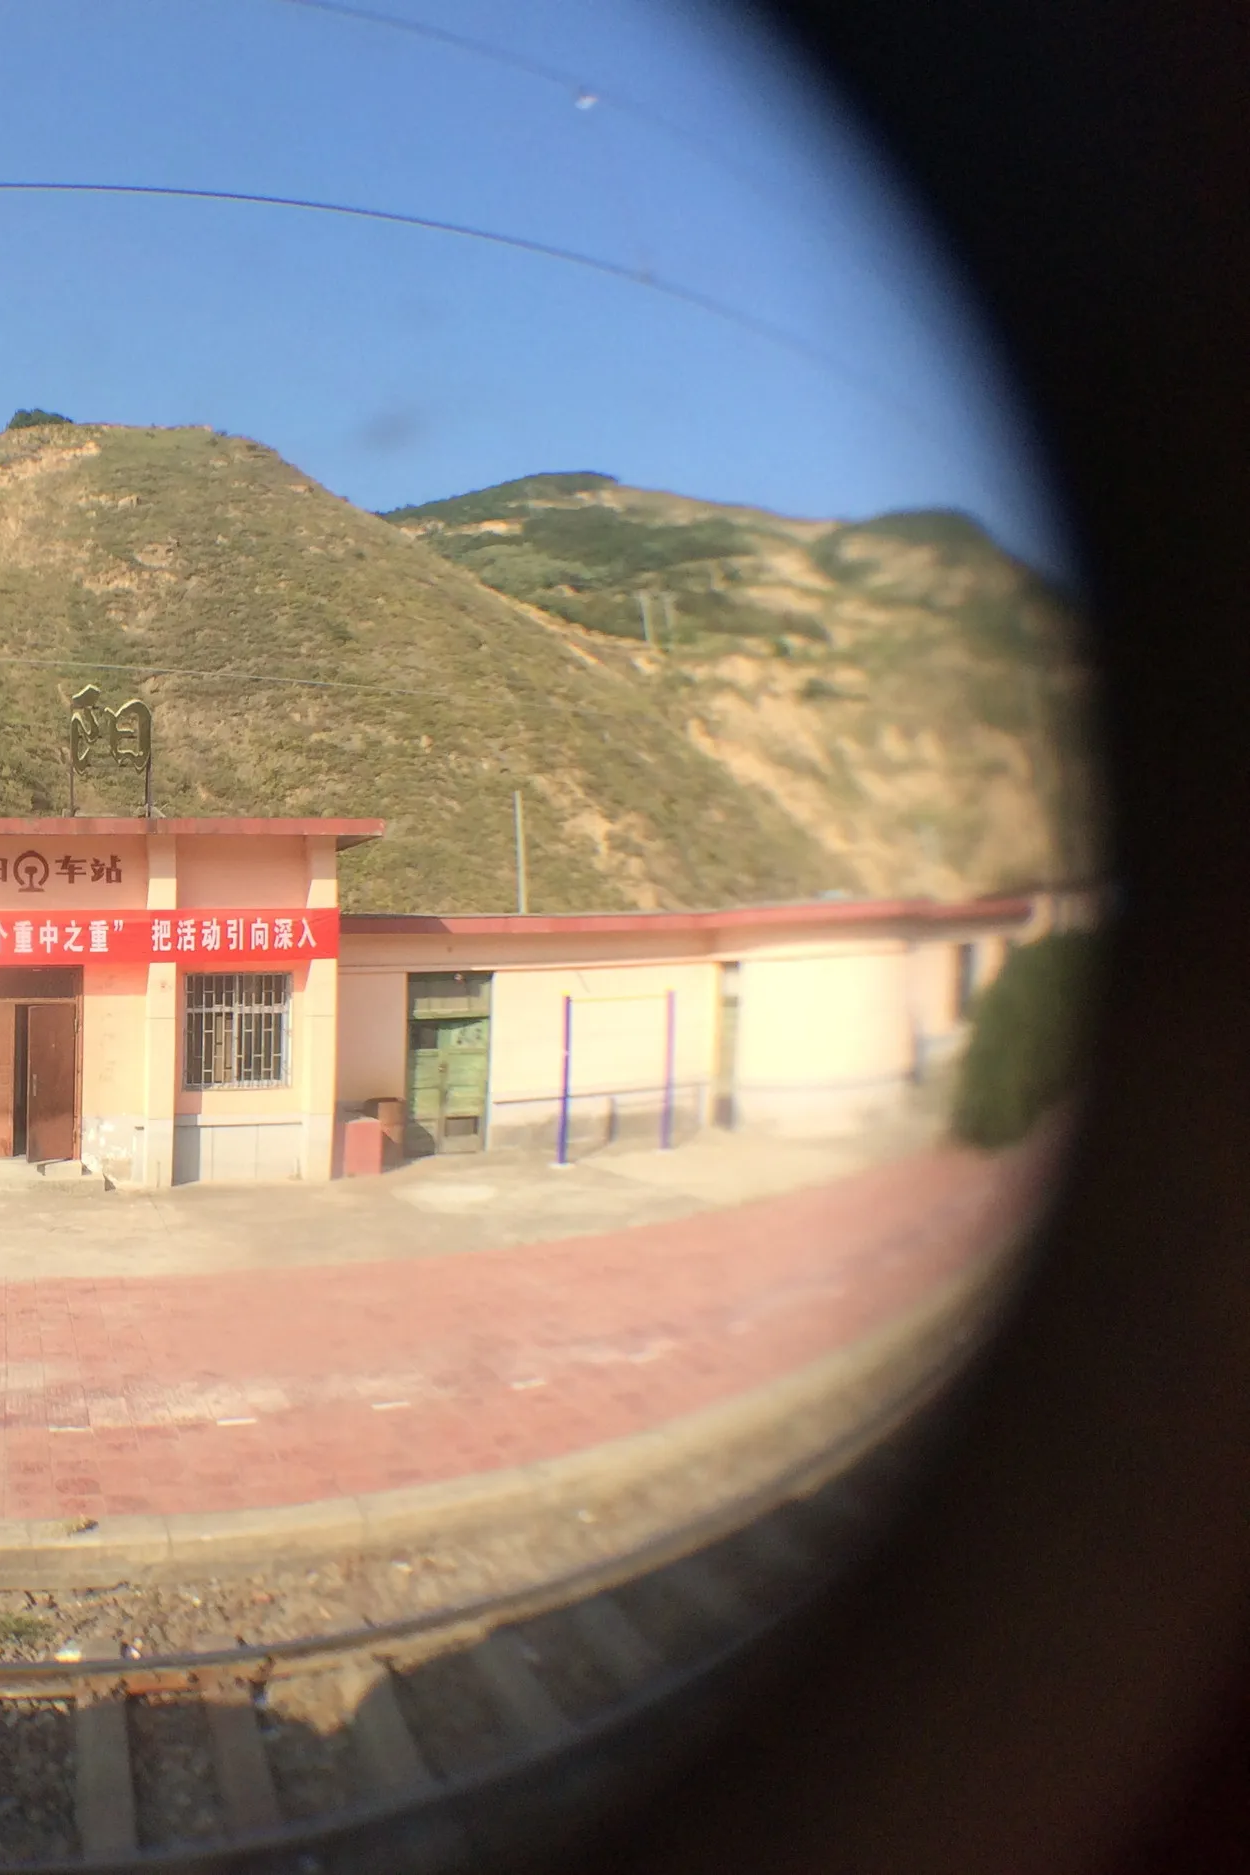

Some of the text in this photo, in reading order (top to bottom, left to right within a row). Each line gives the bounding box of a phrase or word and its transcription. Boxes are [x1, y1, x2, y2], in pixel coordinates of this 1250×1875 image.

[54, 854, 122, 884] 车站
[151, 917, 317, 951] 把活动引向深入
